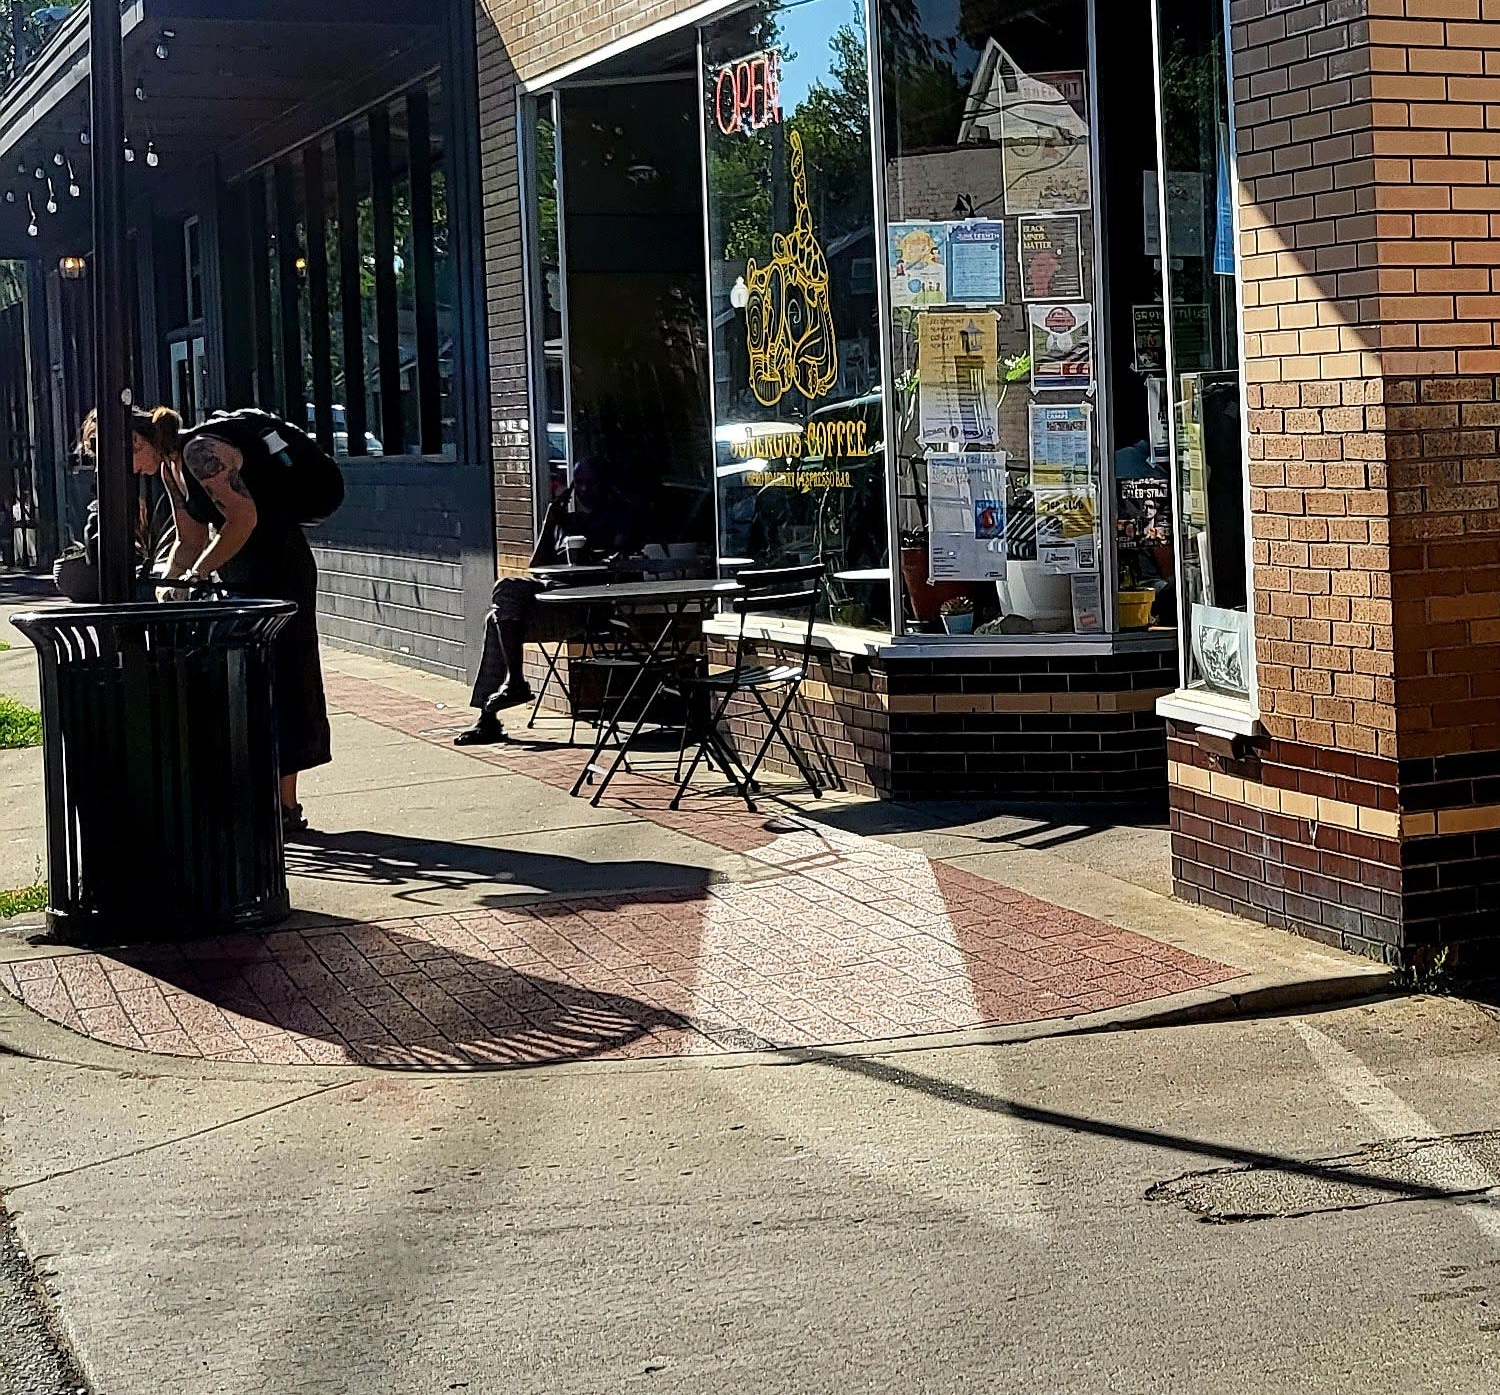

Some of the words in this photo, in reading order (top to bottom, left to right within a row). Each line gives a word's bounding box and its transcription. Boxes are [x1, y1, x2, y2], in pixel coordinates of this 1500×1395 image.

[716, 51, 780, 135] OPEN
[1023, 241, 1052, 250] MATTER
[807, 420, 867, 457] COFFEE
